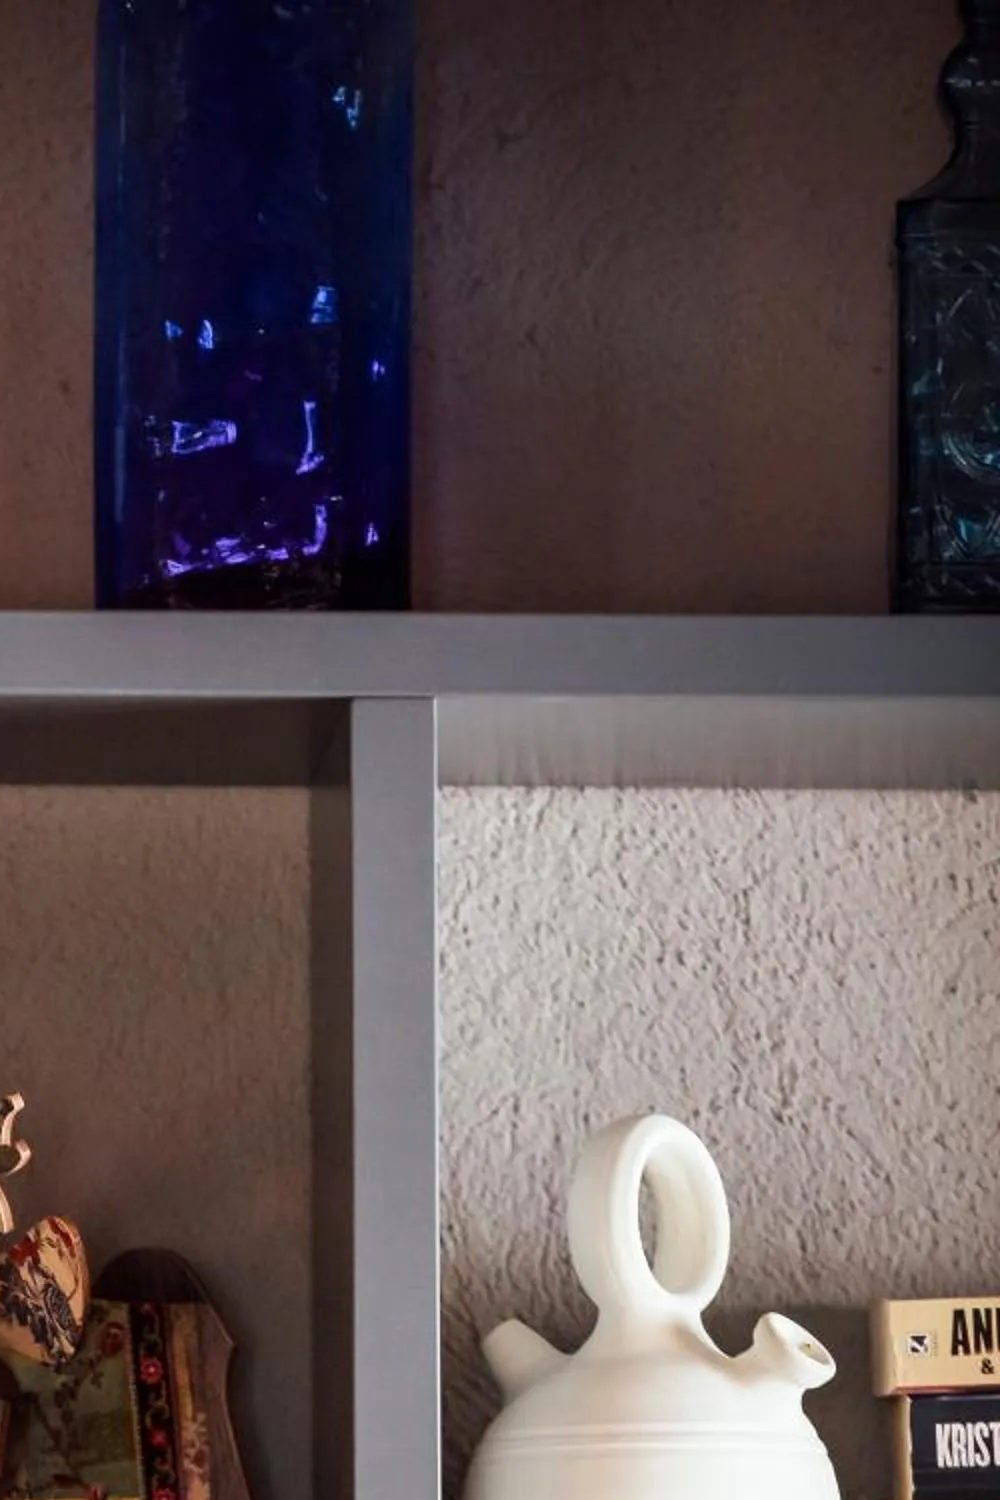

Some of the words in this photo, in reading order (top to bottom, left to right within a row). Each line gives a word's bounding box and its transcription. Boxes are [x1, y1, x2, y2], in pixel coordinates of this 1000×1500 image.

[951, 1307, 1000, 1356] AN
[981, 1357, 994, 1375] &
[935, 1421, 1000, 1469] KRIST
